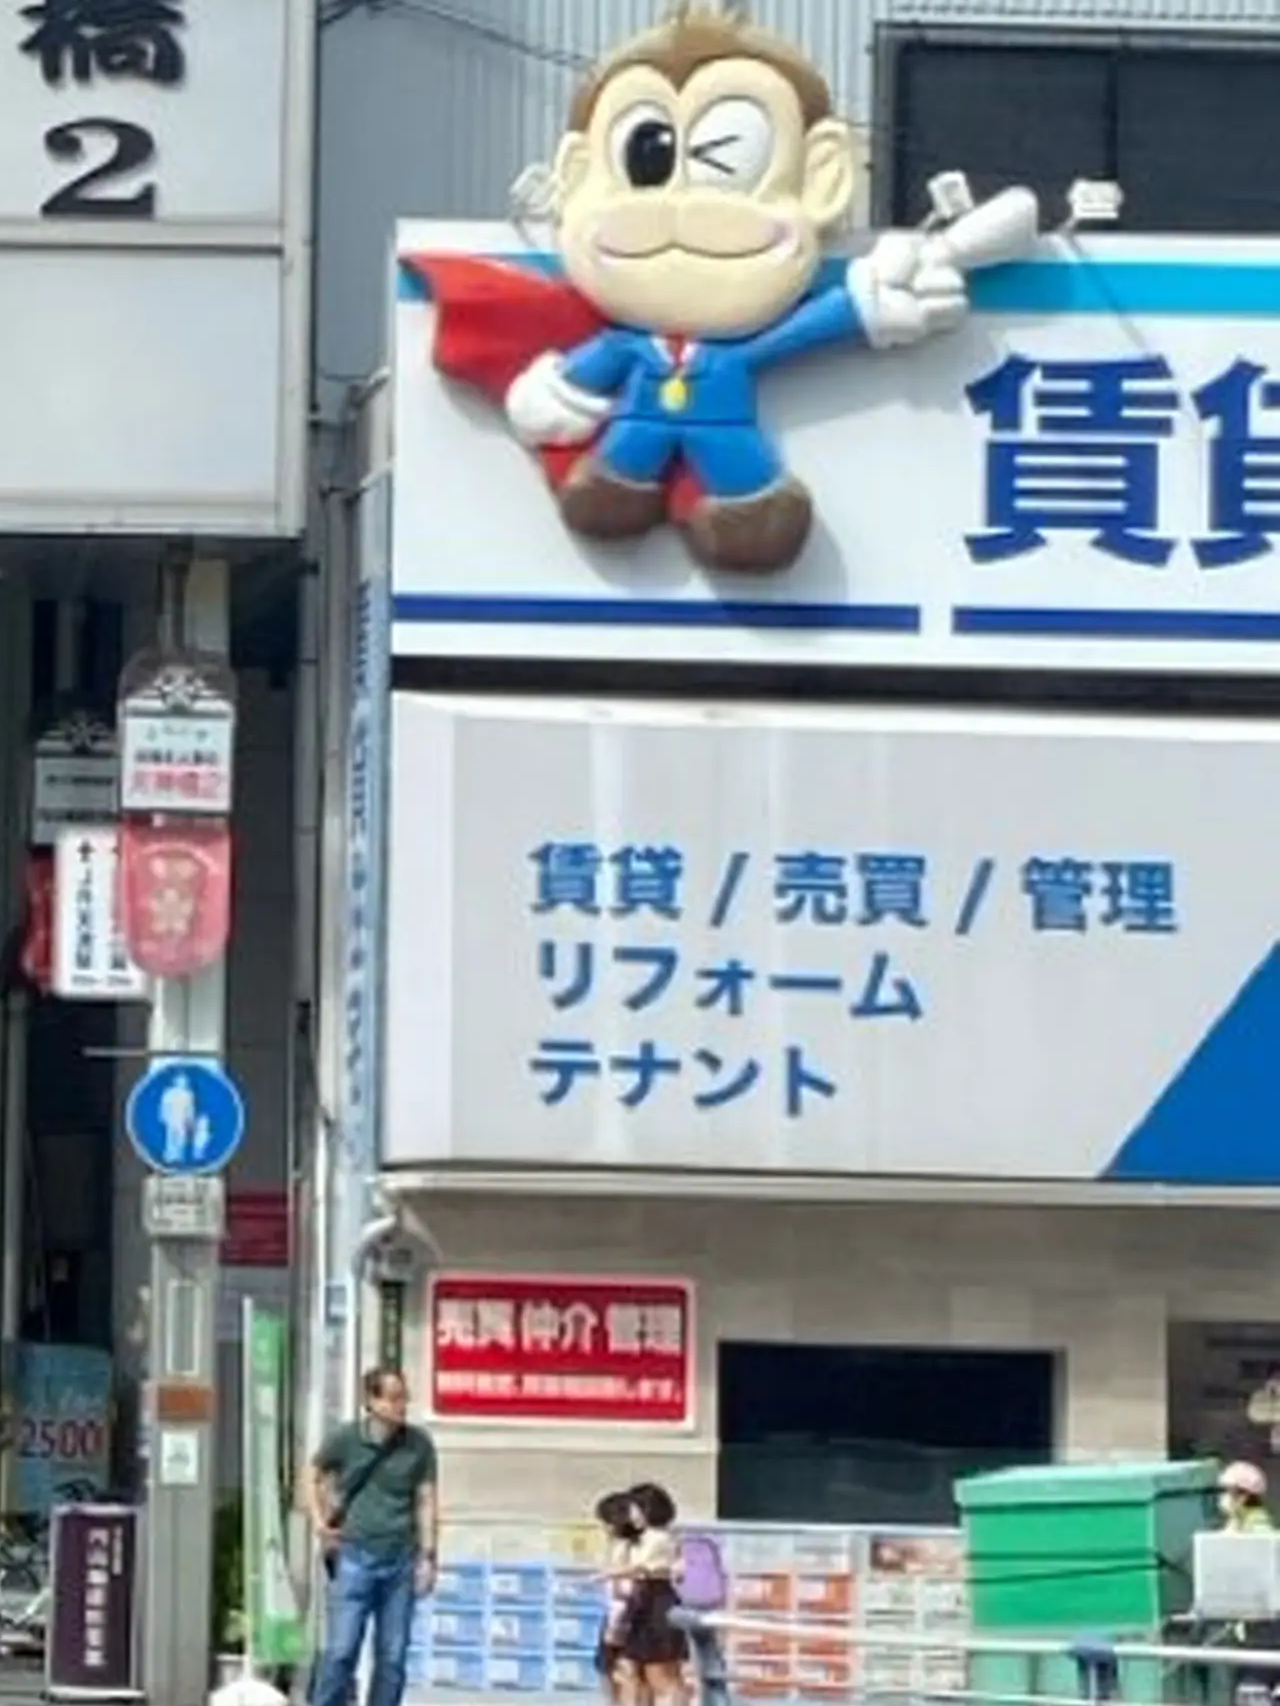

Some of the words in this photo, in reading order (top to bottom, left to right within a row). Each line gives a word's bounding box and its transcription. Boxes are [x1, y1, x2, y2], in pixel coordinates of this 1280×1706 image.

[528, 841, 685, 920] 賃貸
[772, 853, 928, 929] 売買
[1020, 855, 1179, 935] 管理
[536, 941, 926, 1021] リフォーム
[528, 1039, 839, 1118] テナント
[521, 1300, 600, 1355] 仲介
